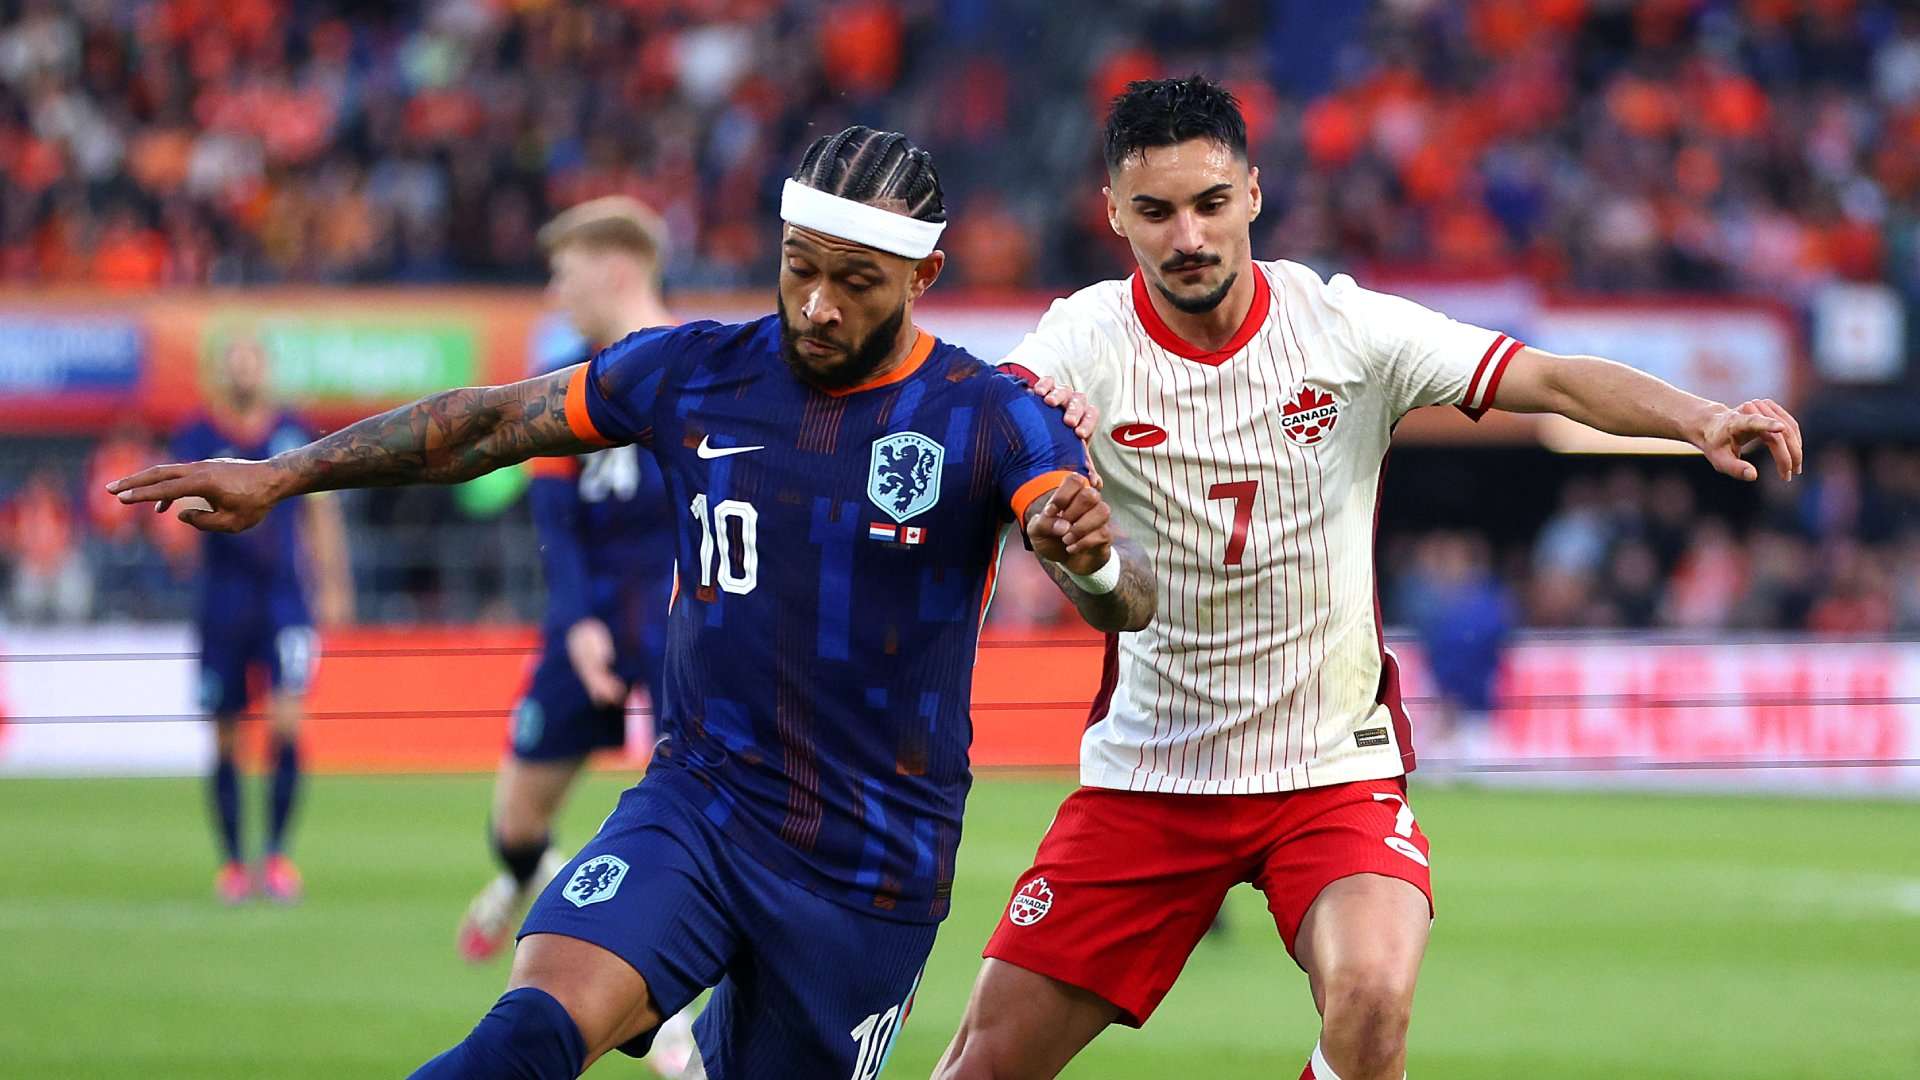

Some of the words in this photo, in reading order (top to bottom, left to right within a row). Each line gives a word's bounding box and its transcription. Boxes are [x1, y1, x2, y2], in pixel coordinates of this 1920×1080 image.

[1281, 406, 1338, 427] CANADA
[690, 493, 759, 595] 10
[1208, 480, 1258, 565] 7
[1372, 793, 1414, 838] 7
[850, 1003, 899, 1080] 10
